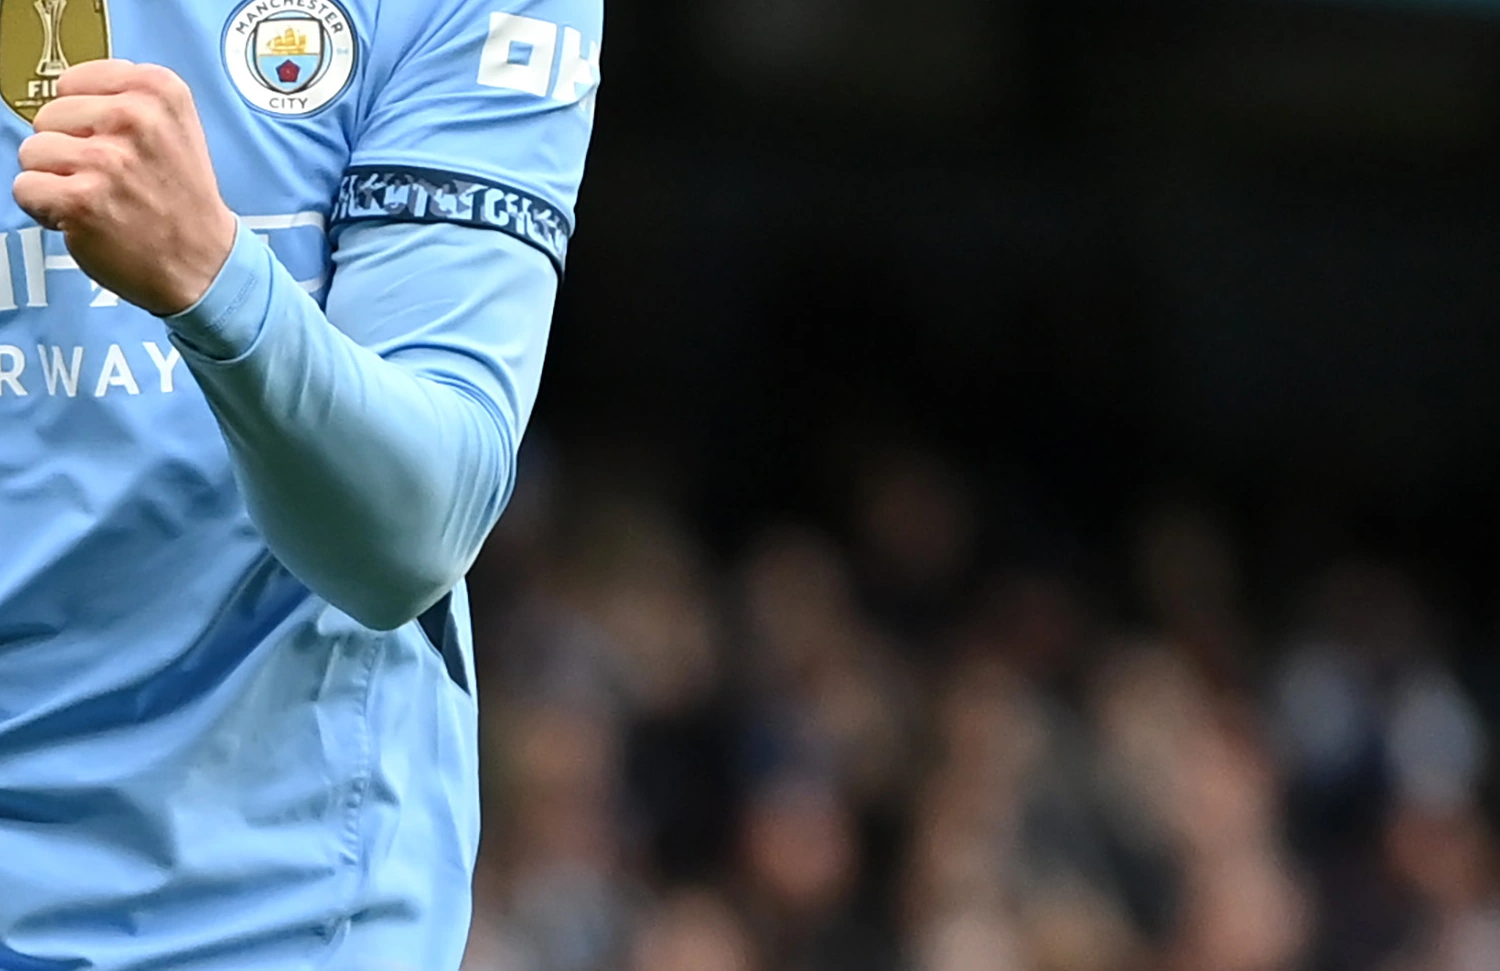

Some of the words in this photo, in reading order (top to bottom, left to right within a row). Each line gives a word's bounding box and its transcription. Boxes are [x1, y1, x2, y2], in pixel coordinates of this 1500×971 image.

[476, 11, 600, 101] OK
[28, 79, 58, 98] FI
[268, 97, 308, 109] CITY
